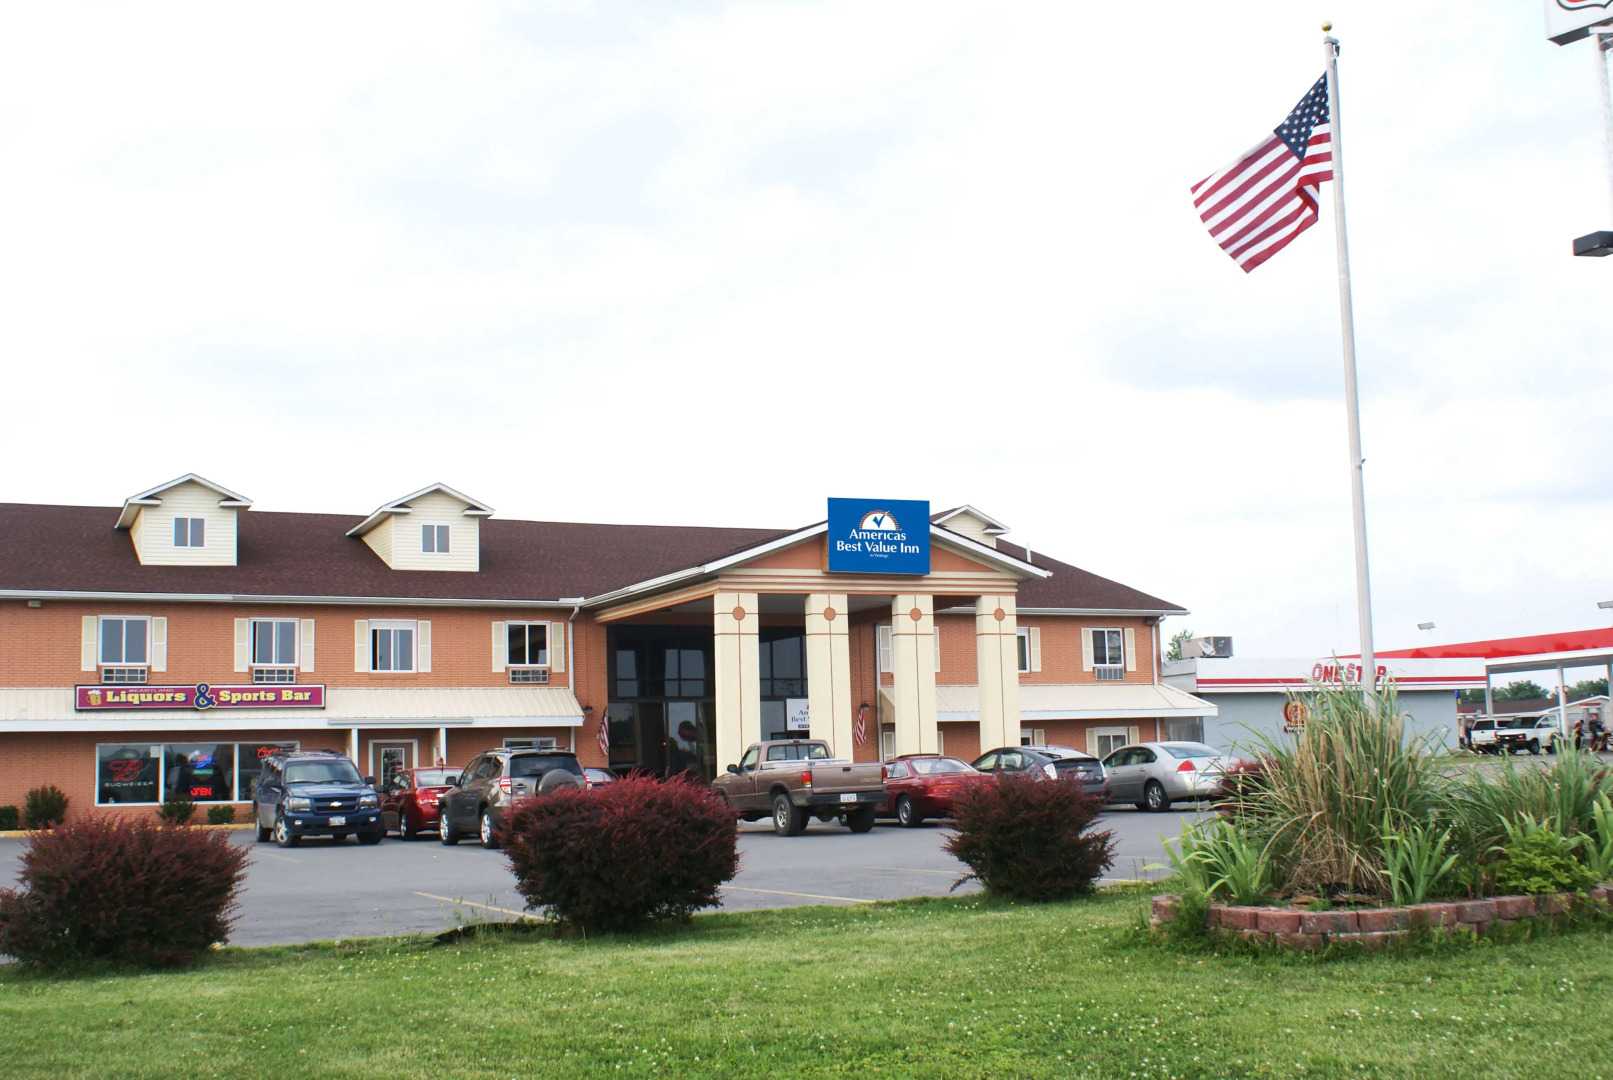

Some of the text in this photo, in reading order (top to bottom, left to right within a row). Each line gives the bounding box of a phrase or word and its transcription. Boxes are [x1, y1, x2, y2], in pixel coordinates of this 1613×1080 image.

[849, 529, 907, 541] Americas
[836, 540, 920, 554] Best Value Inn
[1312, 662, 1387, 683] ONE STP
[106, 682, 312, 710] Liquors & Sports Bar
